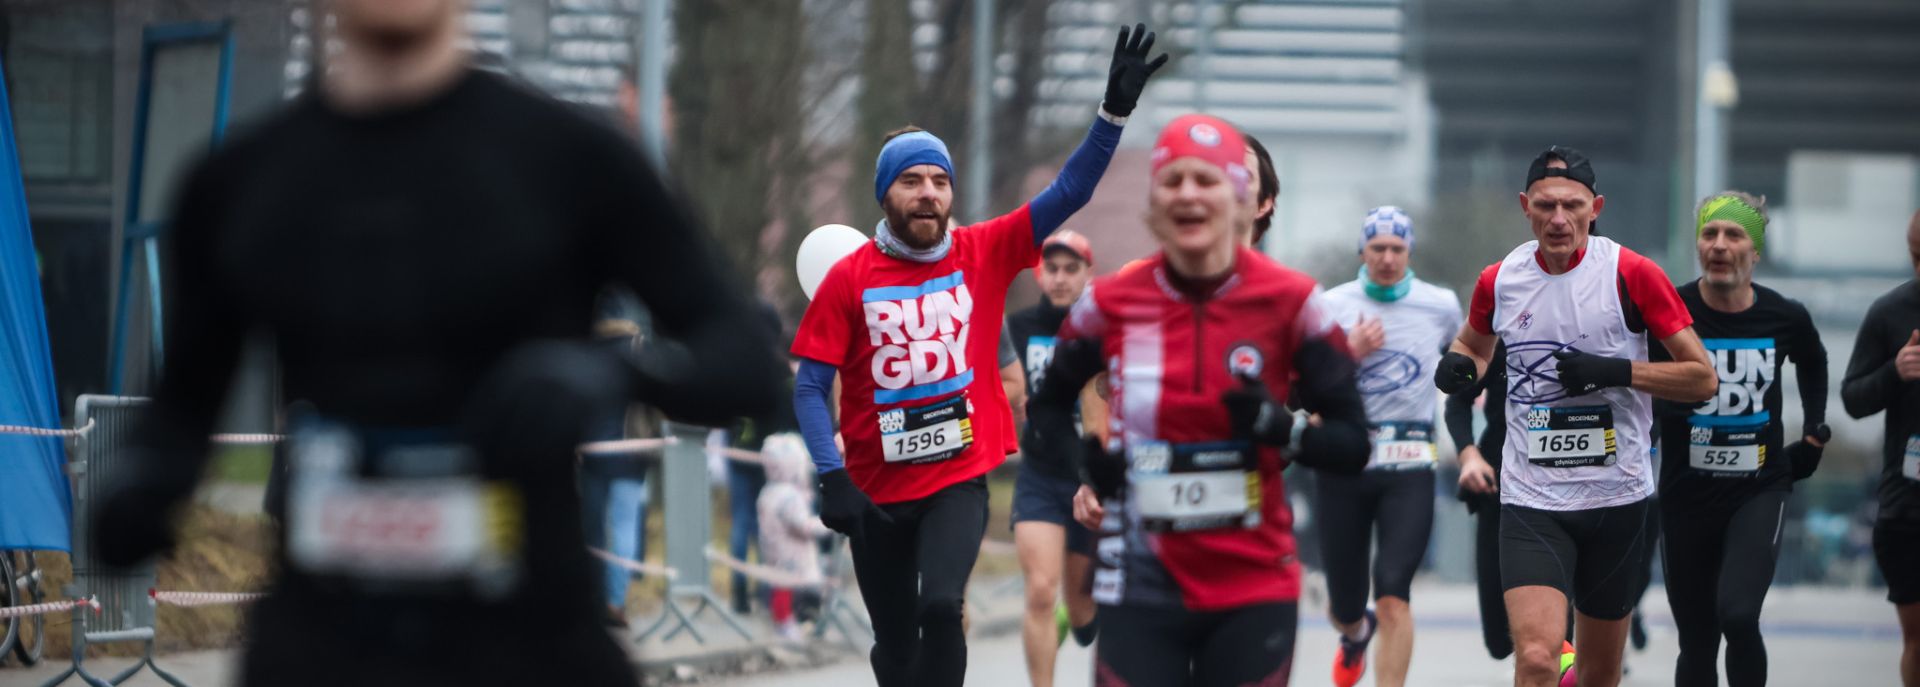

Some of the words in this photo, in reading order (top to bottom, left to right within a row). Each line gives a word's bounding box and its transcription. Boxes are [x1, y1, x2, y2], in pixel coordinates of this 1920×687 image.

[863, 284, 974, 346] RUN
[871, 323, 970, 390] GDY
[878, 411, 905, 424] RUN
[1528, 408, 1551, 420] RUN
[880, 421, 905, 433] GDY
[1528, 418, 1551, 429] GDY
[895, 427, 945, 456] 1596
[1538, 433, 1589, 453] 1656
[1703, 450, 1740, 466] 552
[1170, 481, 1206, 507] 10
